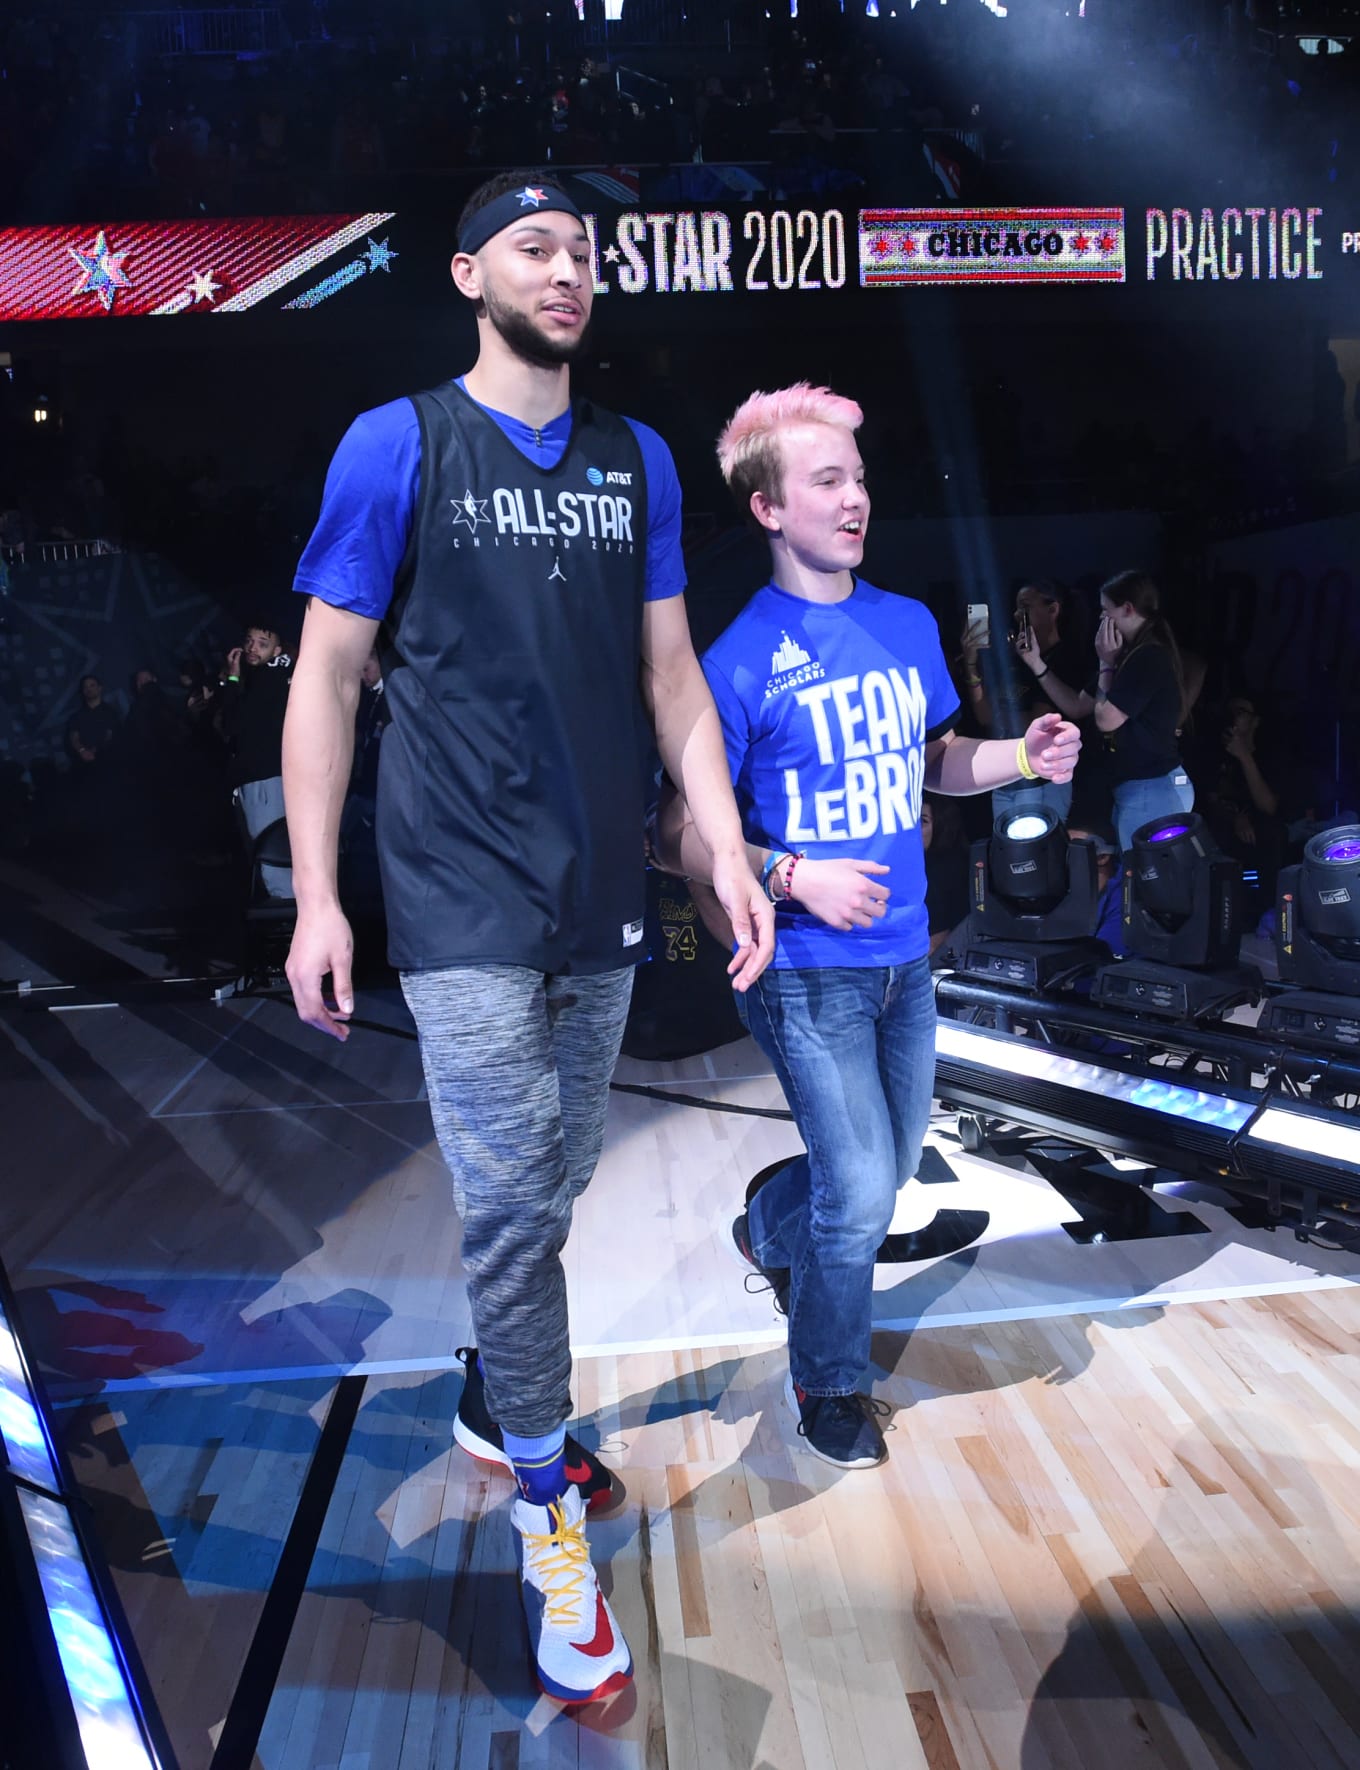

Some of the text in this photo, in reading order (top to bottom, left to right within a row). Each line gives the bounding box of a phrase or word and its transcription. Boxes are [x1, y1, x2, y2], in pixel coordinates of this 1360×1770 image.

[743, 208, 847, 291] 2020
[927, 230, 1064, 257] CHICAGO
[1146, 207, 1323, 281] PRACTICE
[606, 471, 633, 486] AT&T
[492, 488, 634, 542] ALL-STAR
[453, 536, 634, 554] CHICAGO 2020
[764, 667, 827, 699] SCHOLARS
[766, 661, 820, 688] CHICAGO
[794, 666, 927, 766] TEAM
